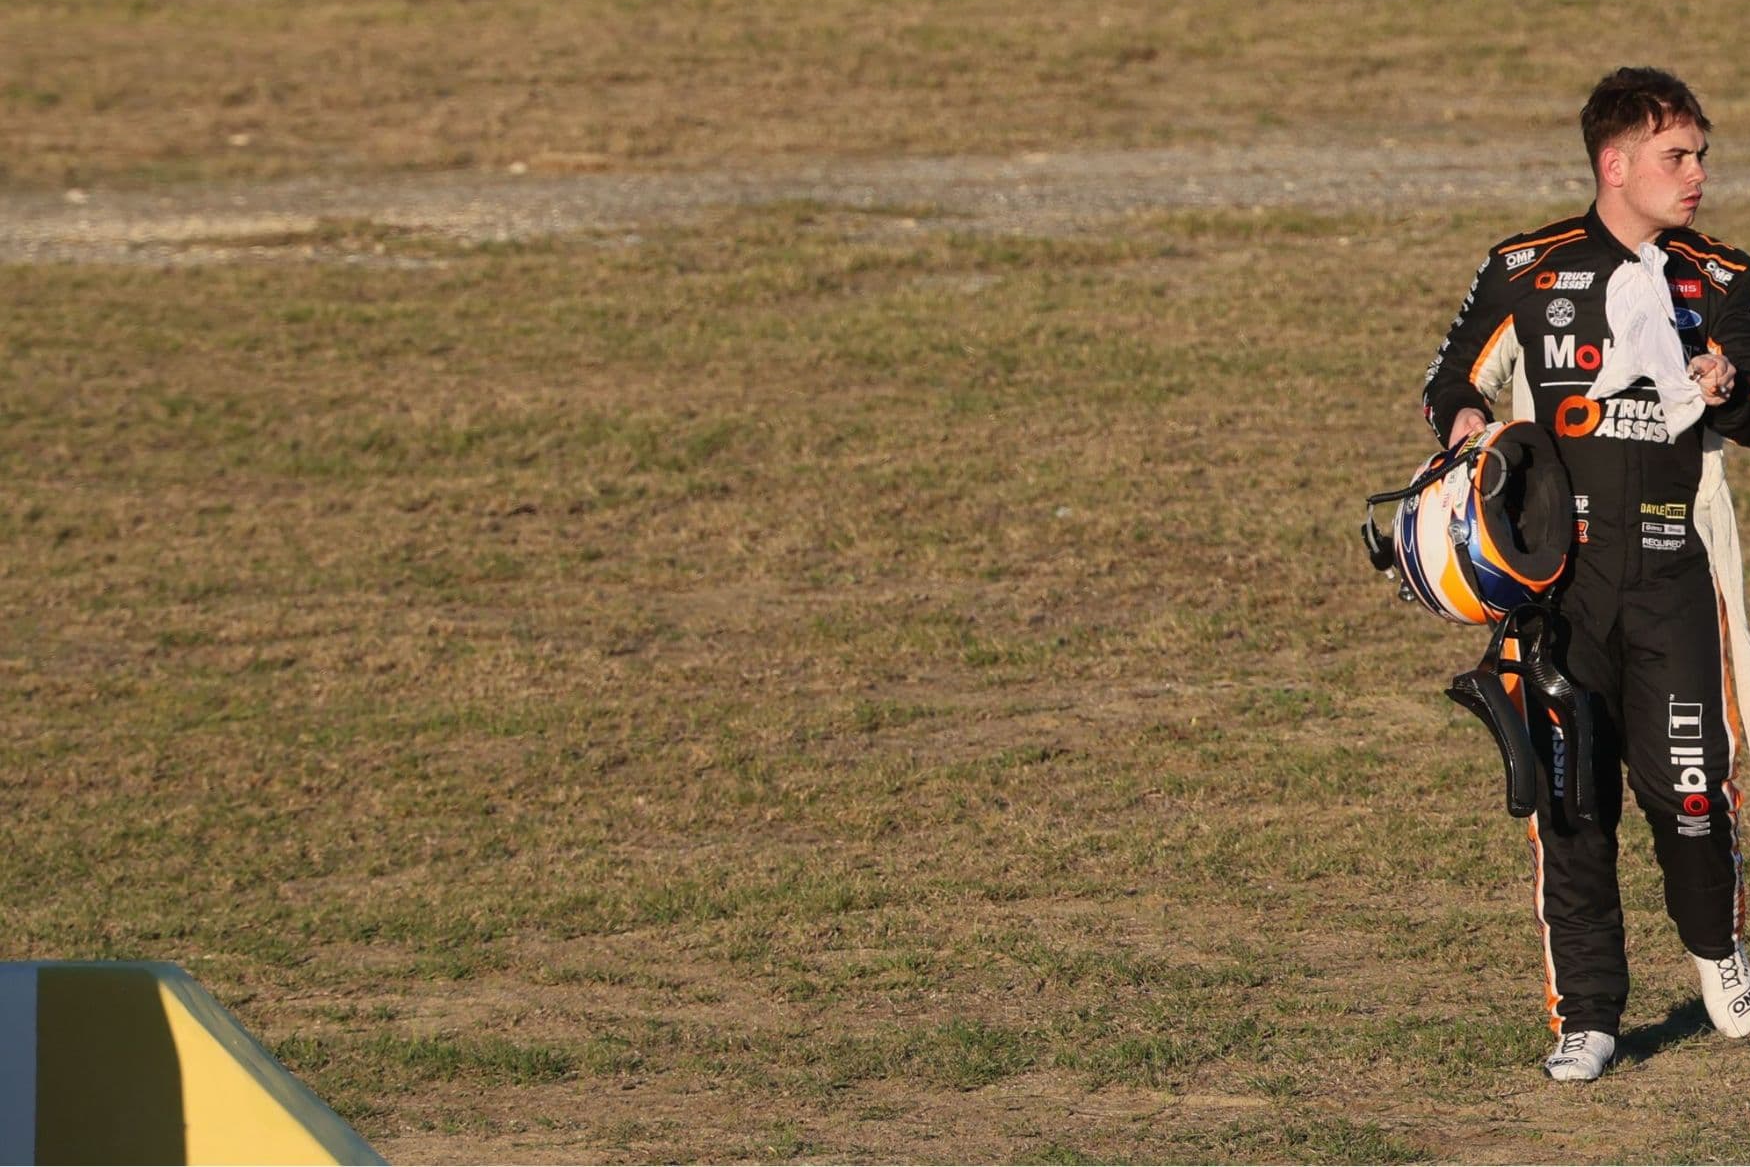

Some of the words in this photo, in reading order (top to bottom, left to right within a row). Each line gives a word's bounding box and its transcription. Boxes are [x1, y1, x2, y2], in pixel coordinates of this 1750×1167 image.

[1506, 250, 1536, 266] OMP
[1558, 272, 1595, 281] TRUCK
[1706, 260, 1733, 283] OMP
[1552, 280, 1592, 289] ASSIST
[1605, 399, 1666, 422] TRUC
[1640, 503, 1665, 516] DAYLE
[1670, 746, 1711, 837] Mobil
